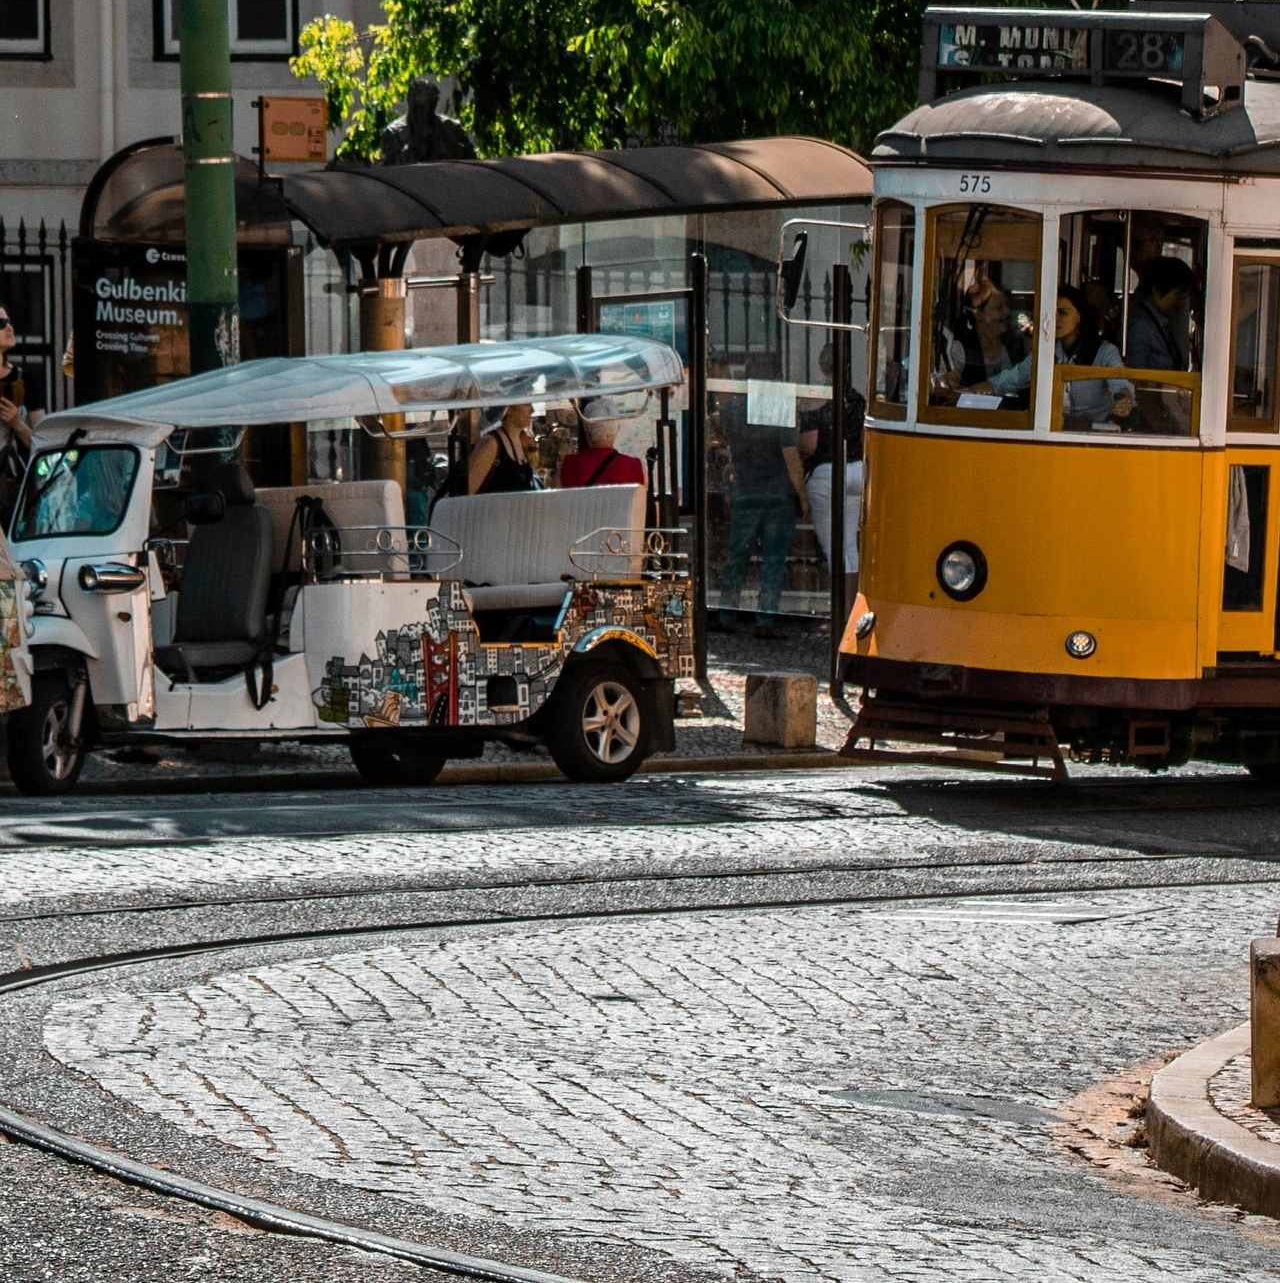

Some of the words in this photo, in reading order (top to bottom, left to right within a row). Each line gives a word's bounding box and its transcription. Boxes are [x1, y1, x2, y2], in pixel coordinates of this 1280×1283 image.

[1118, 32, 1164, 68] 28
[960, 175, 991, 193] 575
[96, 277, 187, 302] Gulbenki
[96, 301, 184, 326] Museum.
[96, 330, 128, 343] Crossing
[130, 331, 160, 343] Cultures
[96, 341, 128, 354] Crossing
